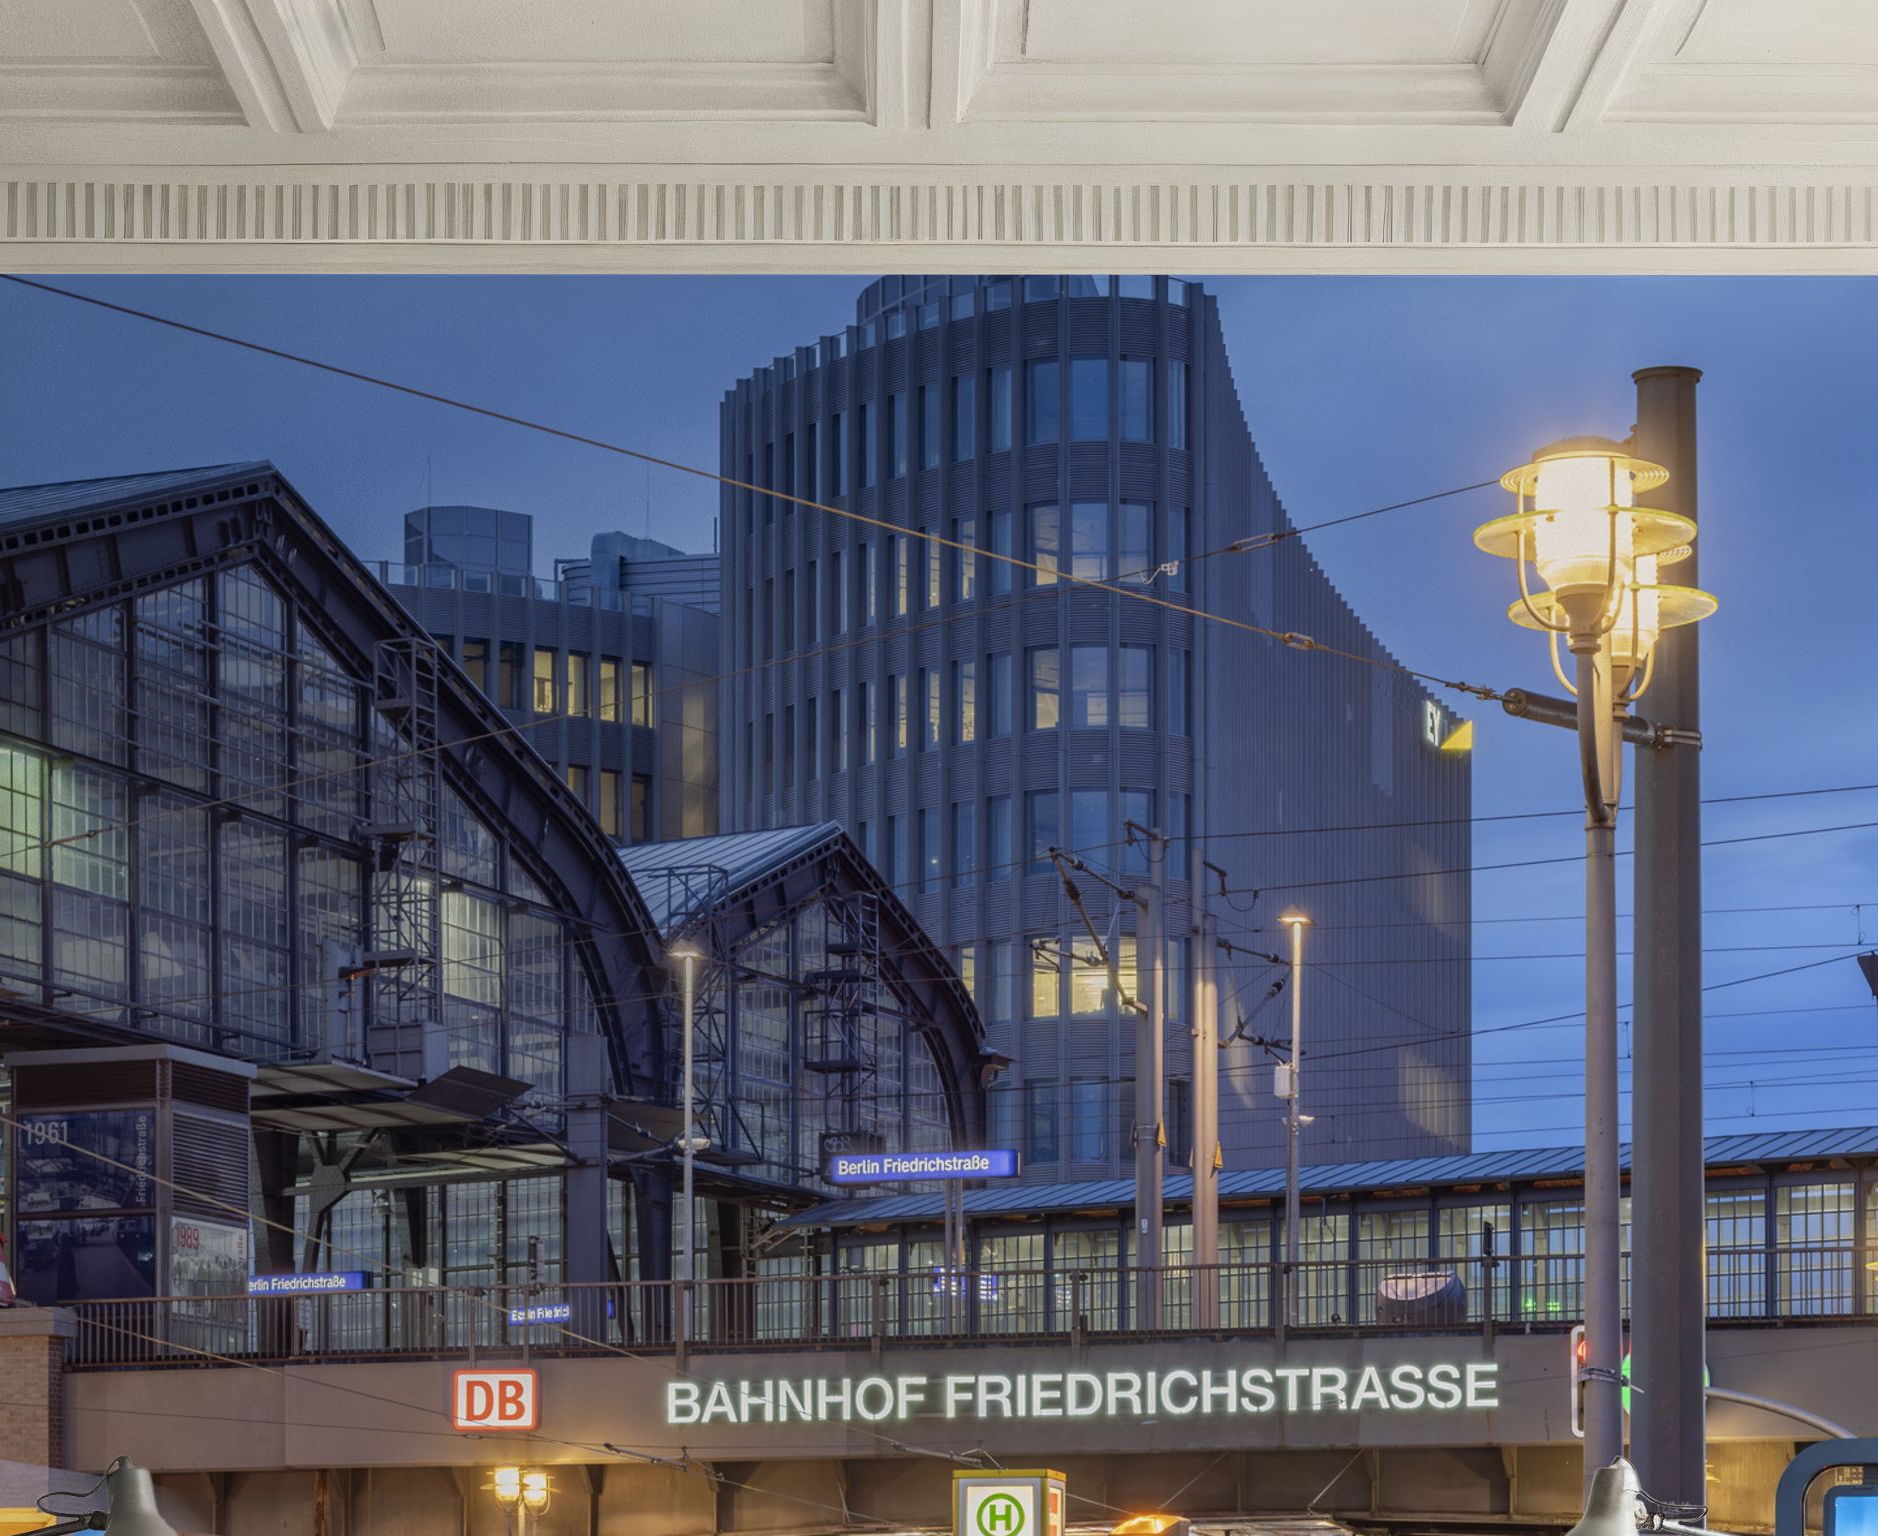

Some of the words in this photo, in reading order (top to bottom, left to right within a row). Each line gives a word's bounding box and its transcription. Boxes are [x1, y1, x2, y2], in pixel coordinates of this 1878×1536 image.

[26, 1121, 68, 1145] 1961
[837, 1160, 880, 1176] Berlin
[882, 1154, 990, 1174] Friedrichstraße
[175, 1225, 201, 1249] 1989
[249, 1279, 269, 1292] erlin
[270, 1275, 346, 1291] Friedrichstraße
[464, 1379, 526, 1422] DB
[667, 1377, 927, 1424] BAHNHOF
[945, 1363, 1500, 1419] FRIEDRICHSTRASSE
